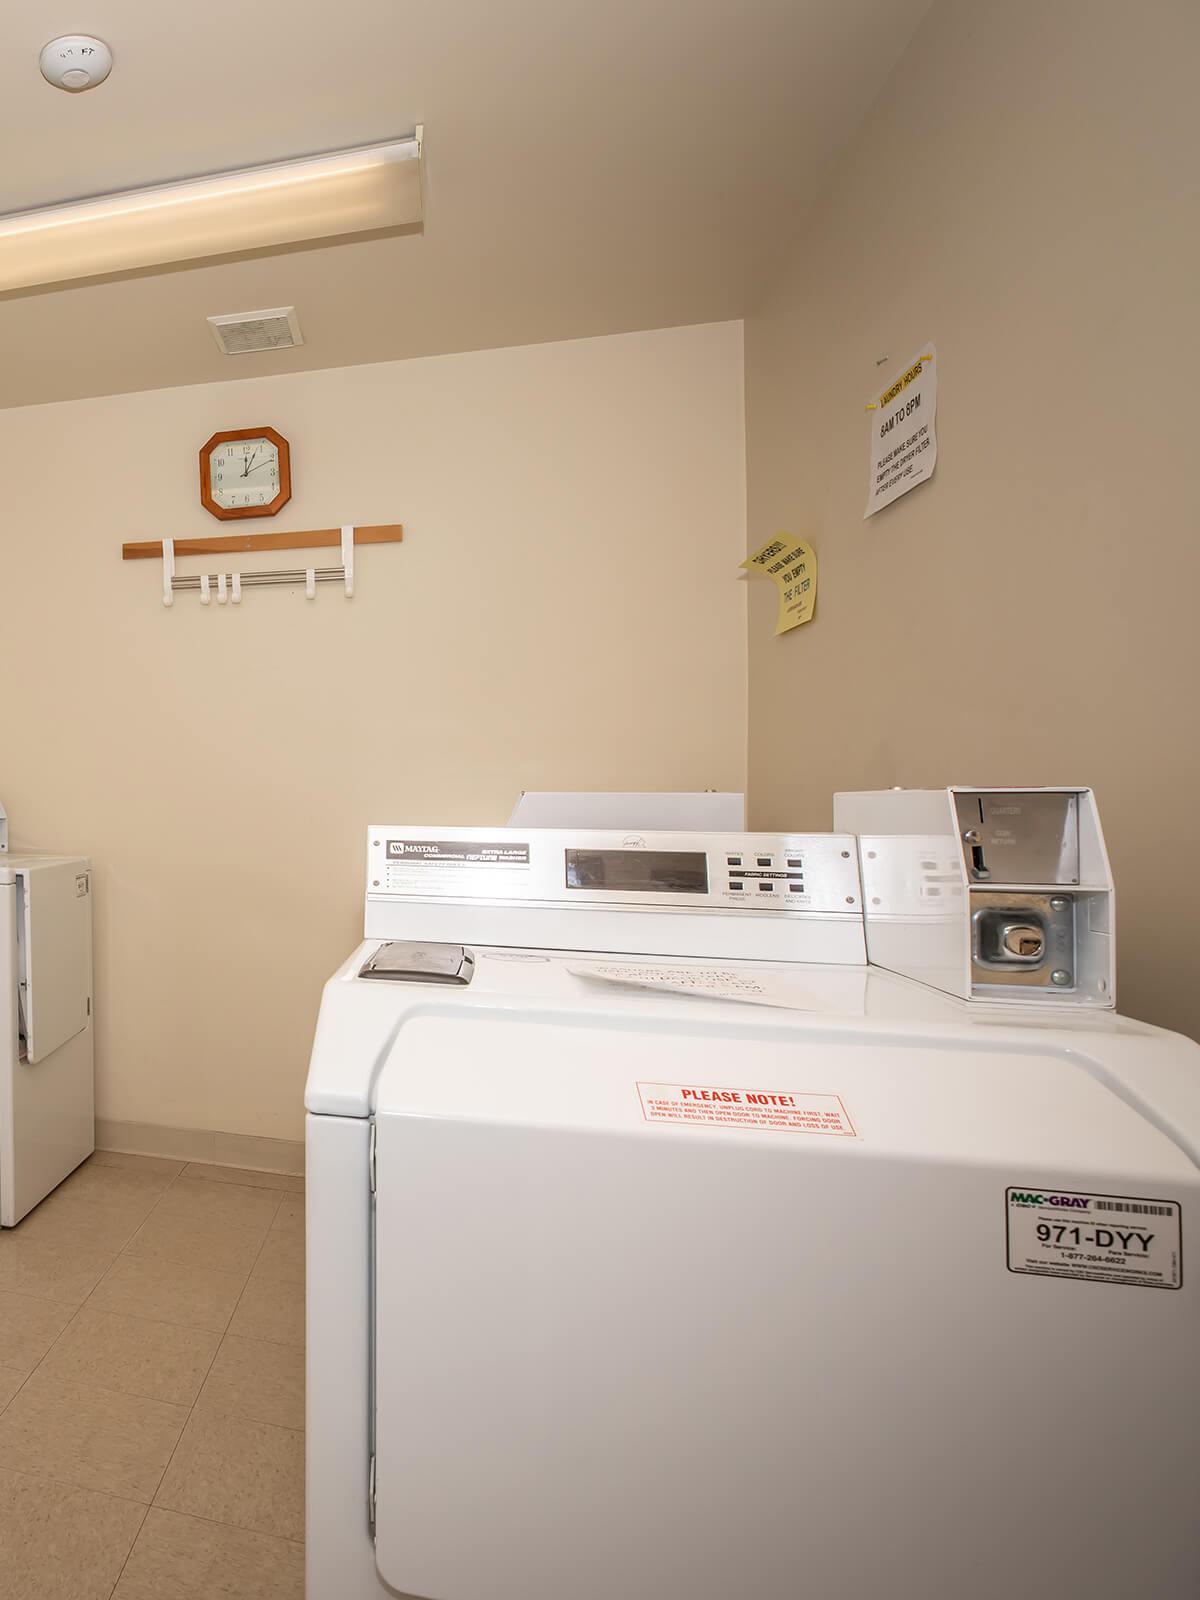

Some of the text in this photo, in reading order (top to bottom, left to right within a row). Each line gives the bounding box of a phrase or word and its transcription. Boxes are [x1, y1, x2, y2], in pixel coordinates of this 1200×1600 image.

[879, 362, 923, 408] LAUNDRY HOURS
[895, 410, 905, 423] TO
[877, 424, 928, 470] PLEASE SURE YOU
[900, 450, 914, 467] DRYER
[915, 437, 930, 457] FILTER
[404, 845, 439, 854] MAYTAG
[681, 1089, 796, 1107] PLEASE NOTE!
[1036, 1223, 1155, 1252] 971-DYY
